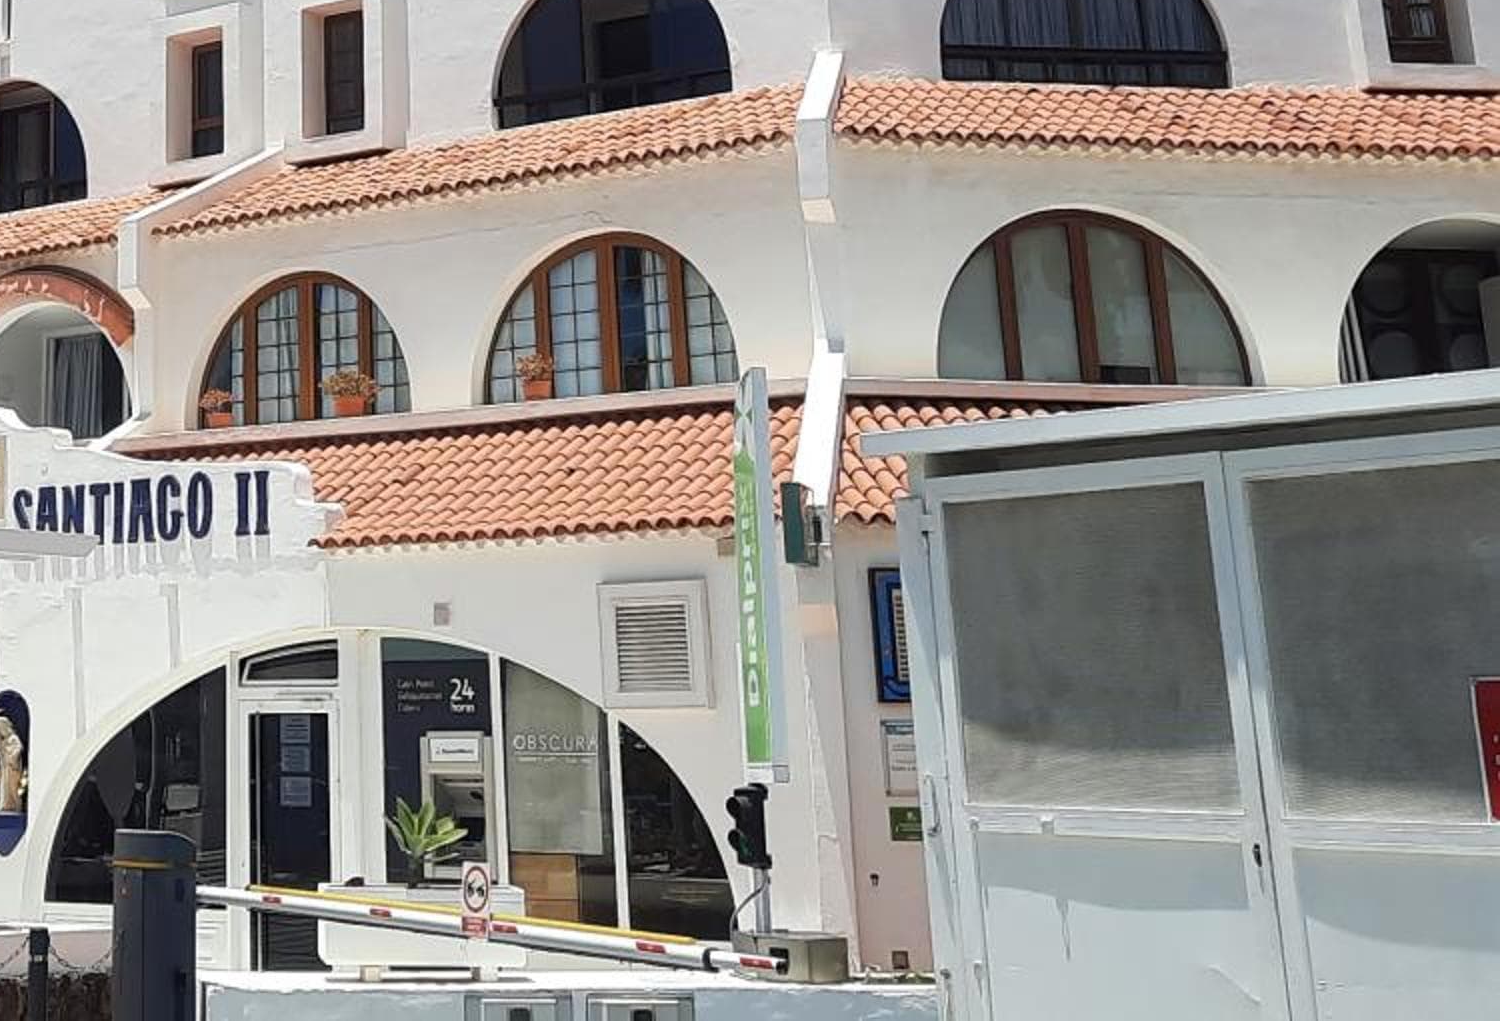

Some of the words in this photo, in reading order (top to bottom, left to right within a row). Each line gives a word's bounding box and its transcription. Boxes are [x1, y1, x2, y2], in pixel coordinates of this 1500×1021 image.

[13, 471, 213, 546] SANTIAGO
[235, 470, 270, 536] II
[450, 678, 475, 700] 24
[513, 734, 598, 751] OBSCURA
